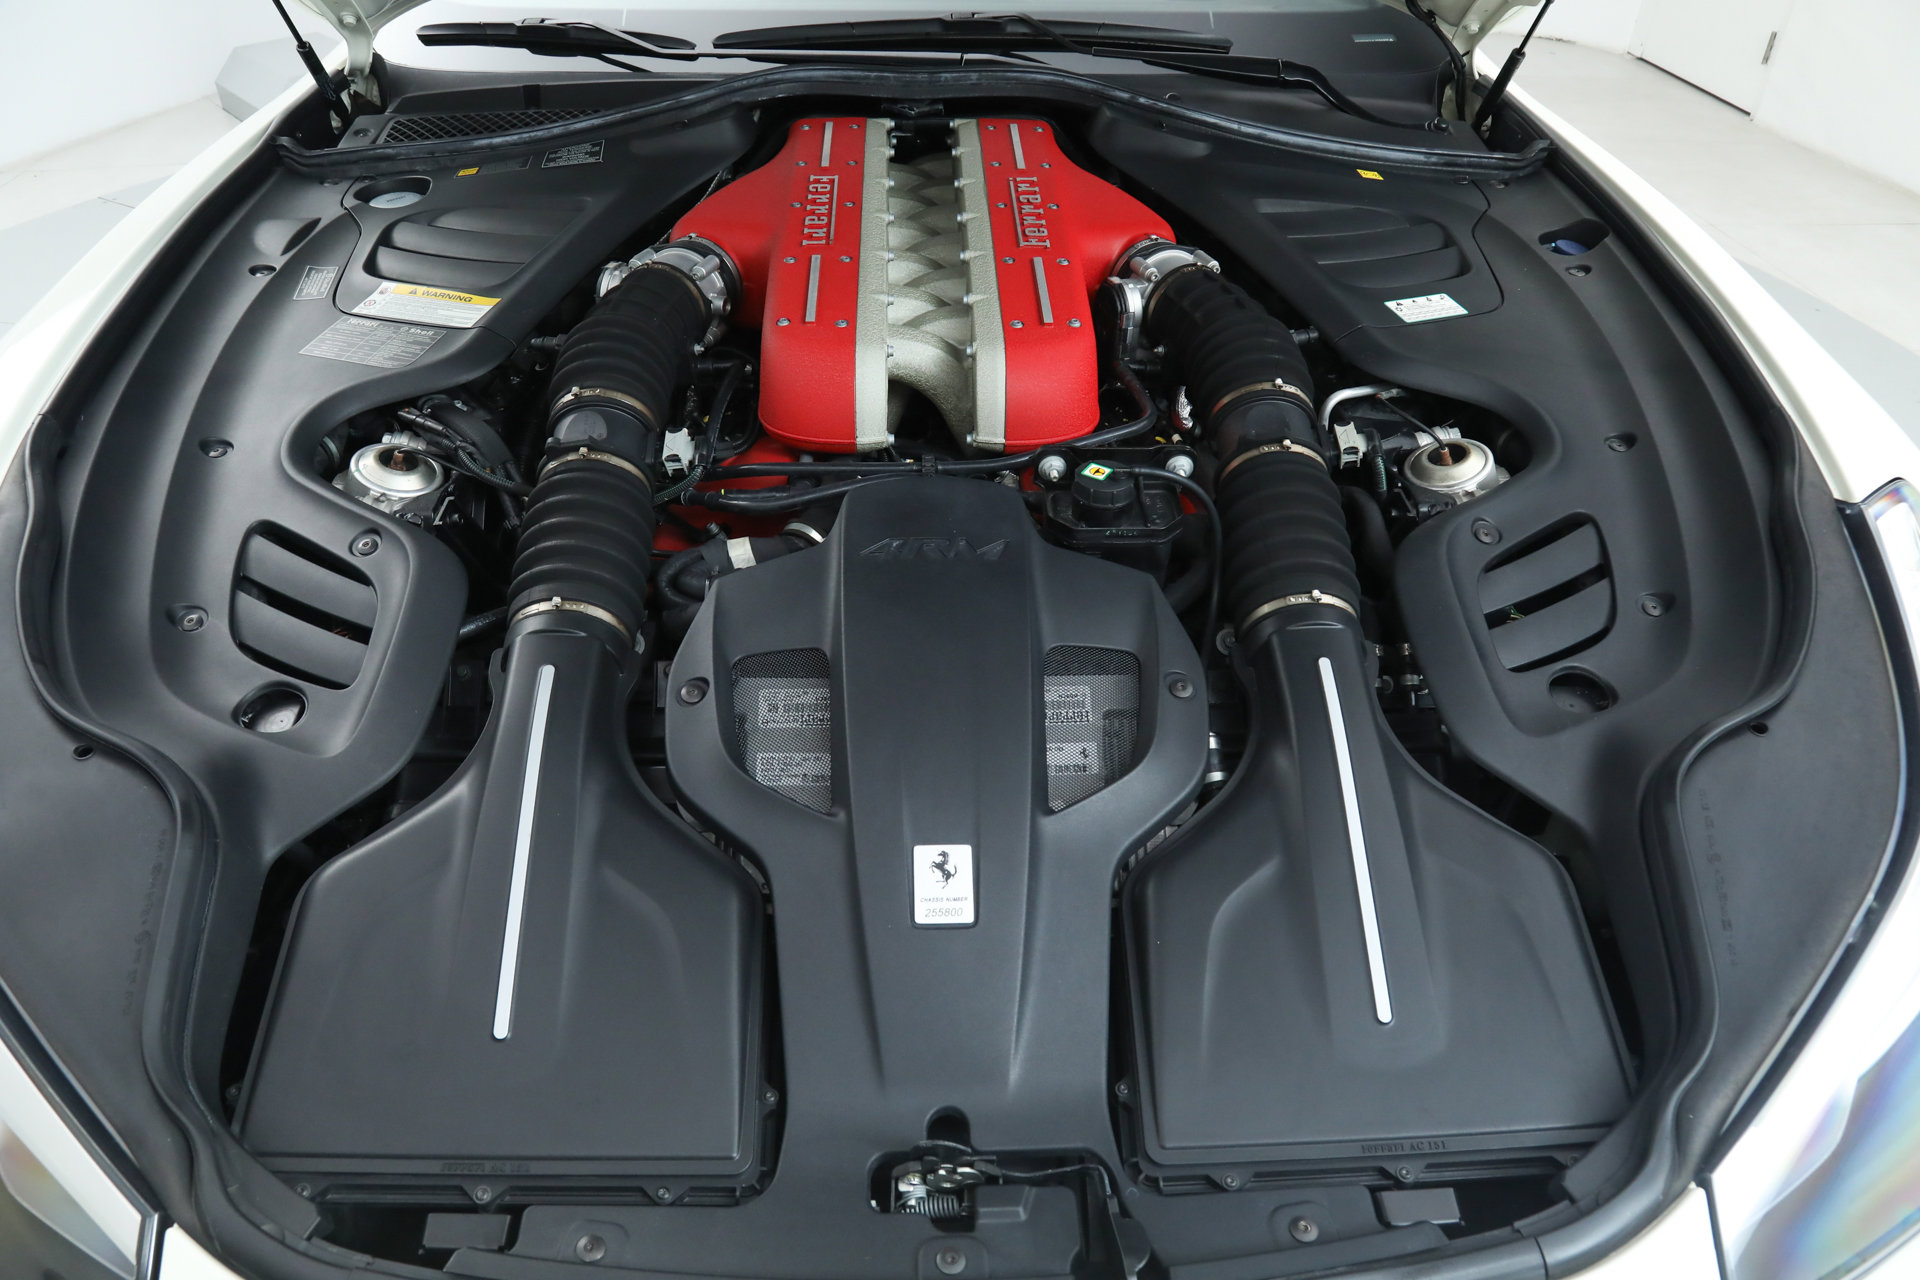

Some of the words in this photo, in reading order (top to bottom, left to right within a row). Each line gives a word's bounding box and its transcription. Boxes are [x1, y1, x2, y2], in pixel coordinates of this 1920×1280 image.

[802, 174, 839, 246] Ferrari
[1008, 176, 1051, 248] Ferrari
[421, 289, 473, 303] WARNING
[408, 327, 435, 336] Shell
[925, 906, 963, 918] 255800
[1409, 1141, 1425, 1151] AC
